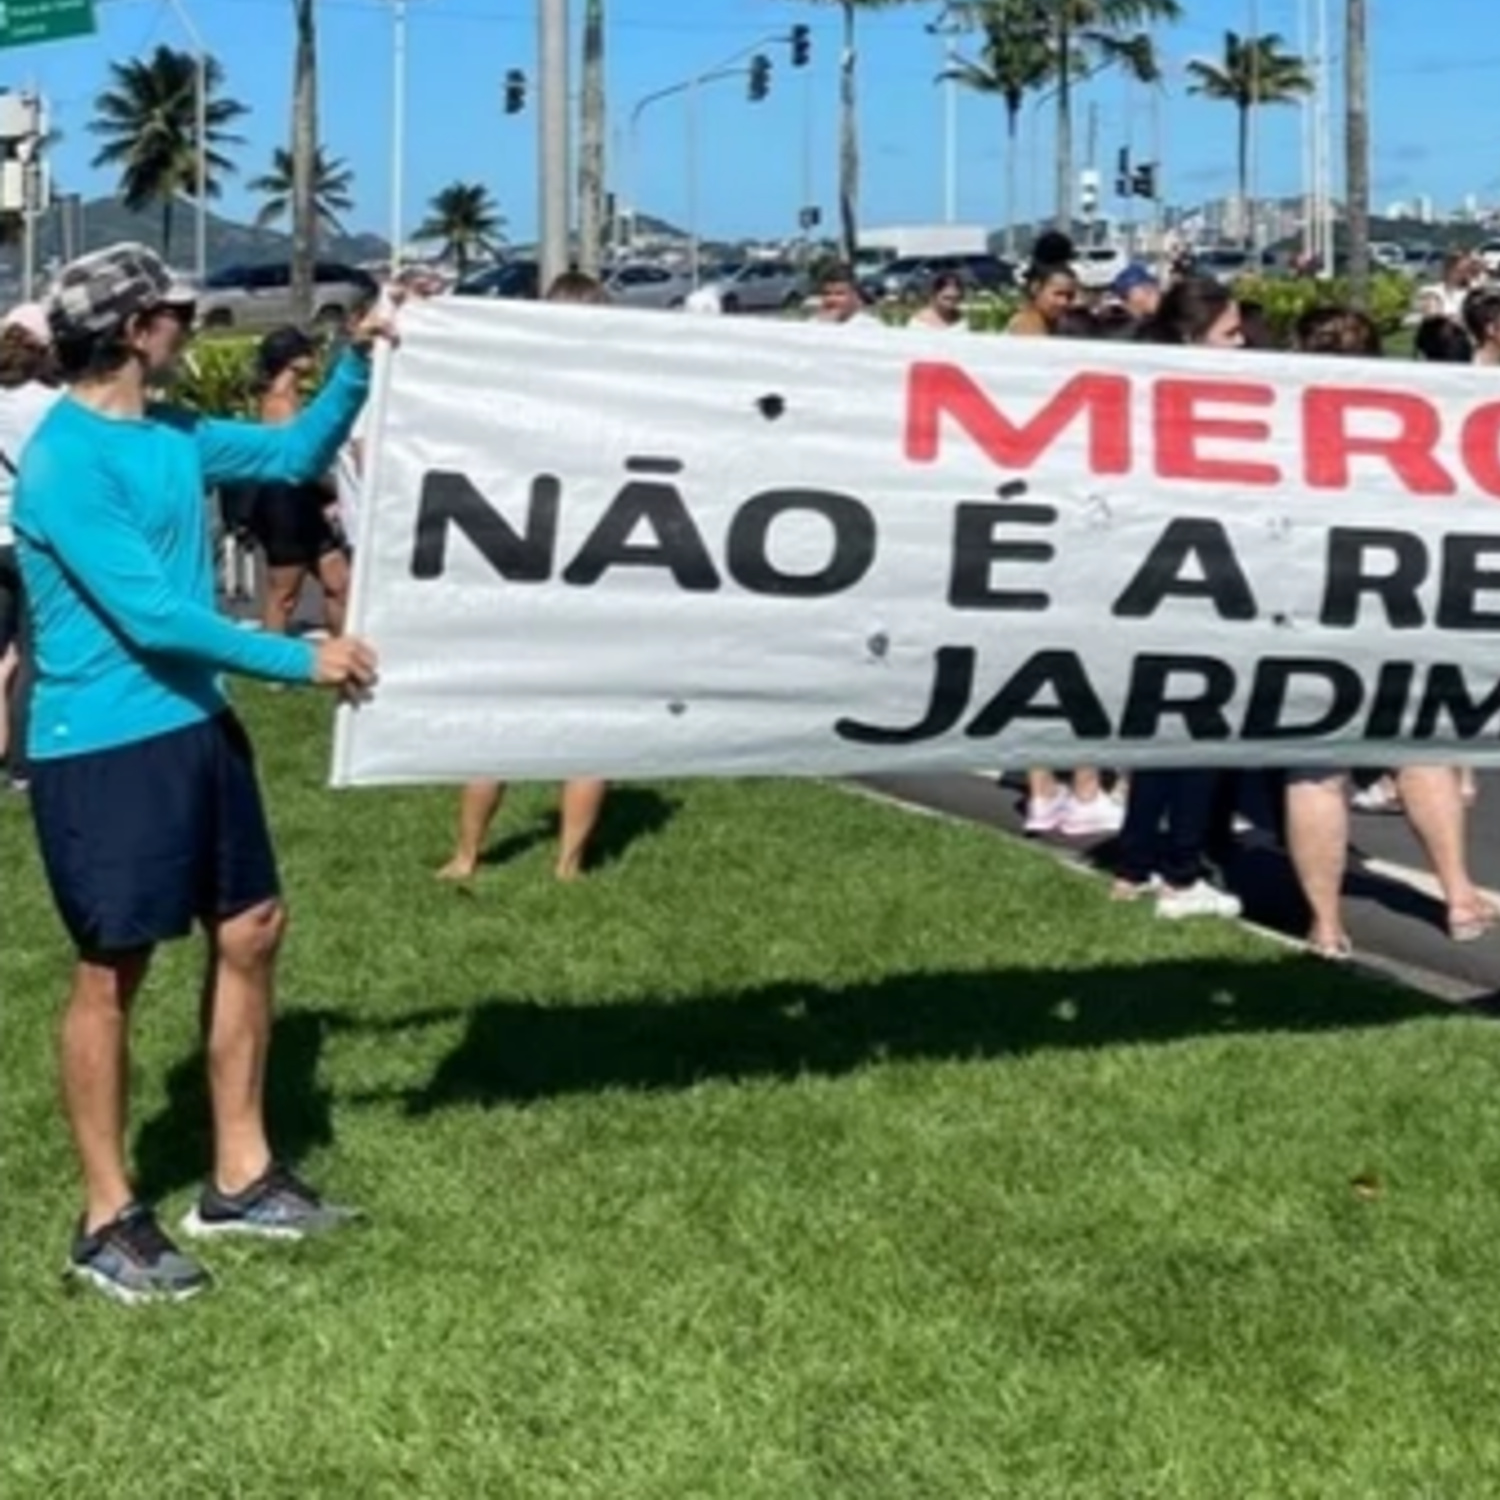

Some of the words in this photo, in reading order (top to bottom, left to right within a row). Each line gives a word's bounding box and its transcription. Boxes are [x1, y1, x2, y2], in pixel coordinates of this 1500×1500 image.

[410, 457, 877, 597] NÃO
[948, 480, 1057, 610] É
[1111, 517, 1257, 621] A
